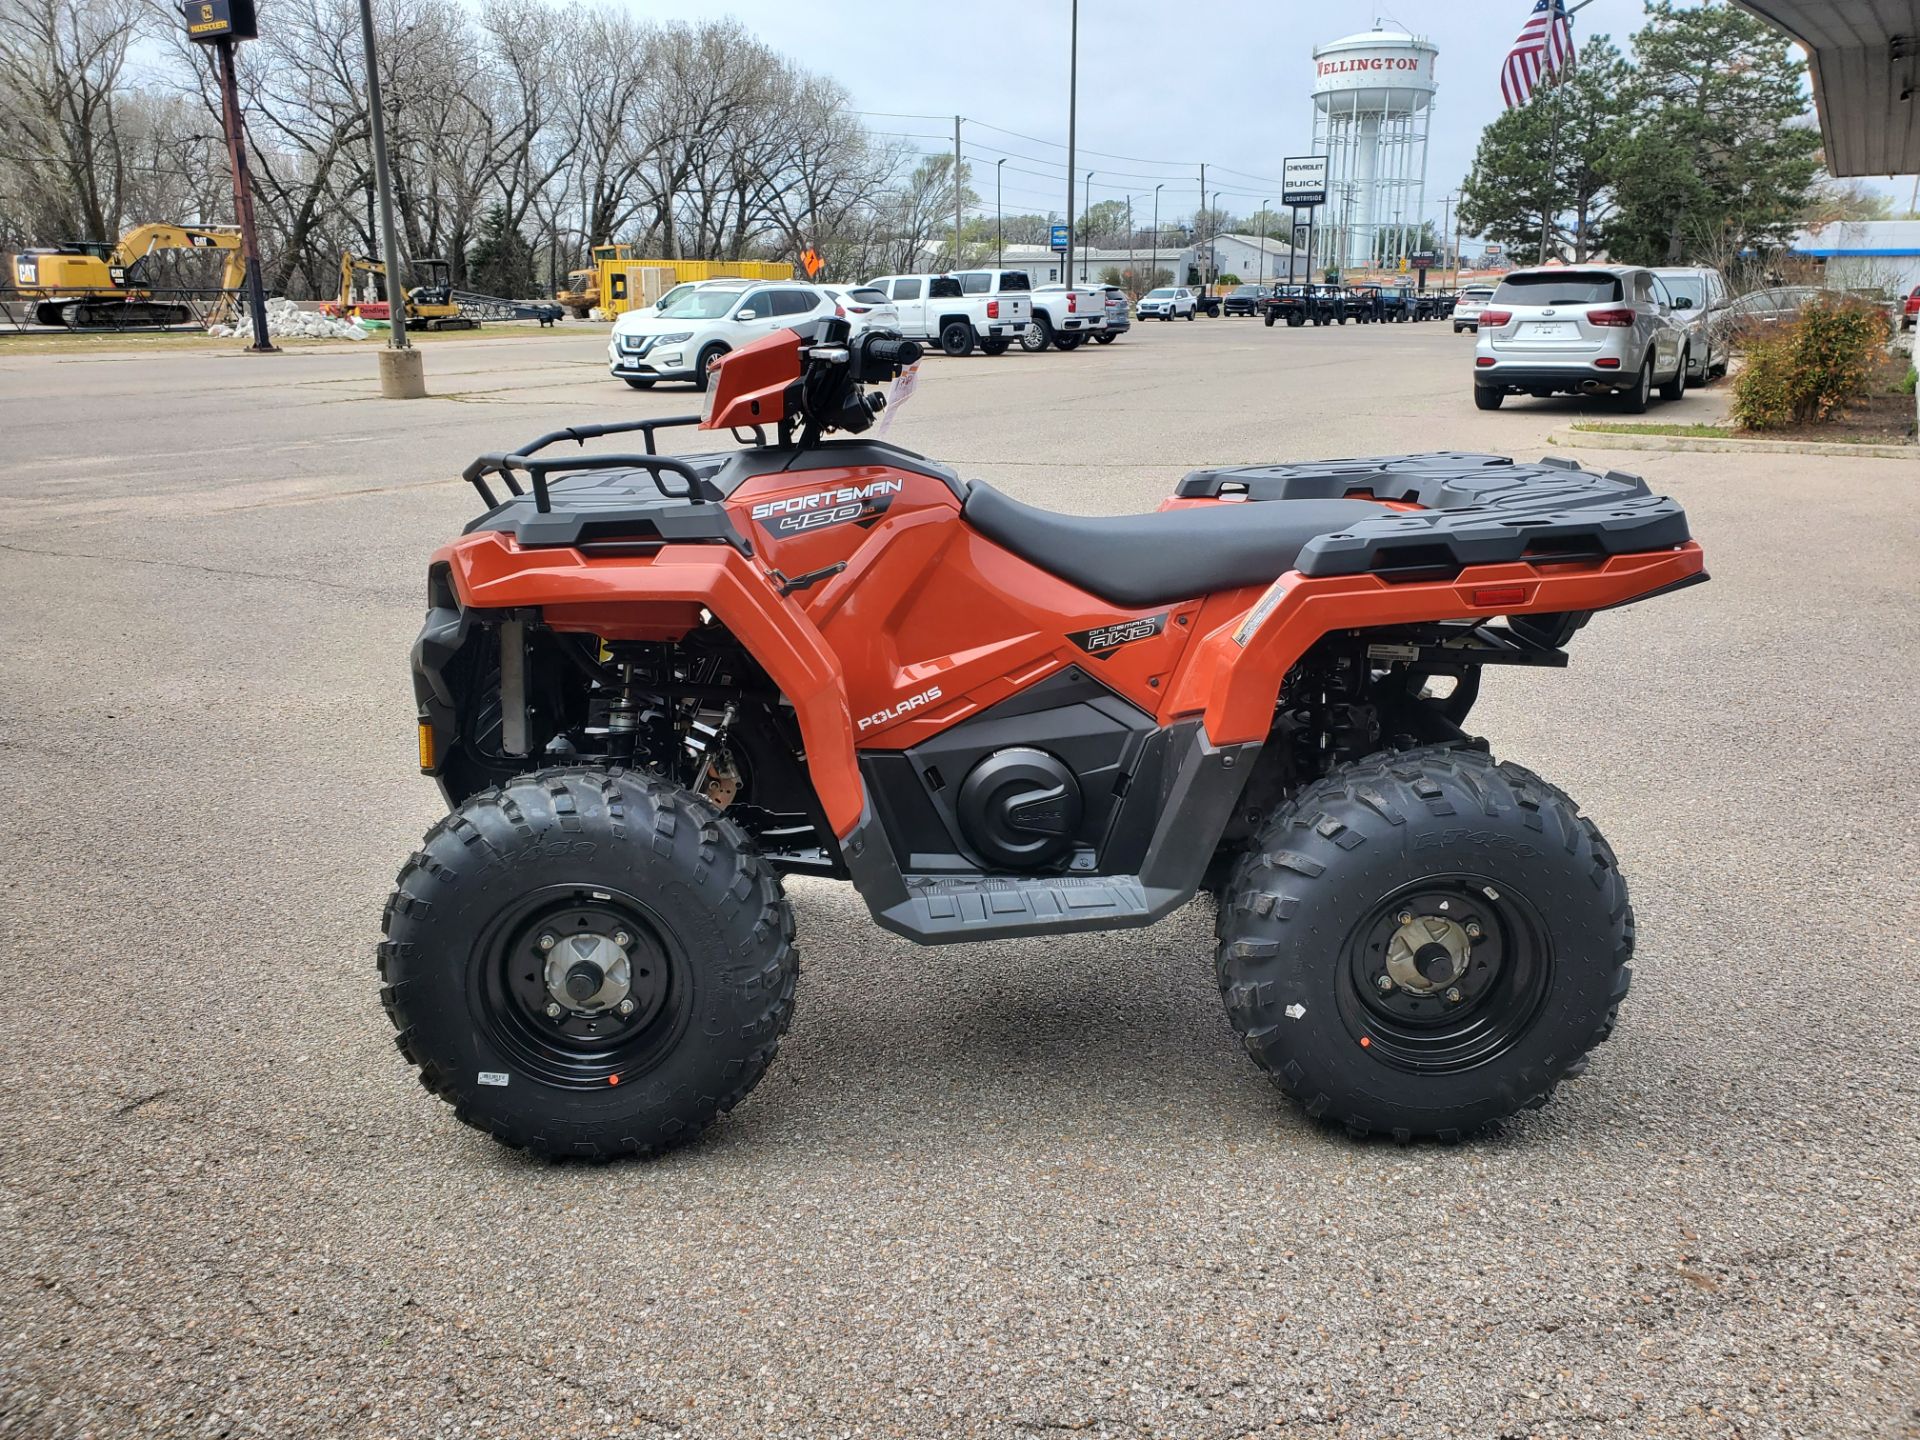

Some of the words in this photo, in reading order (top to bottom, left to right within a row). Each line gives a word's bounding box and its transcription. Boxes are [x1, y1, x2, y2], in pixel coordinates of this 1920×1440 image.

[1286, 180, 1322, 188] BUICK
[194, 237, 207, 246] CAT
[19, 262, 36, 283] CAT
[111, 268, 124, 278] CAT
[752, 479, 903, 519] SPORTSMAN
[780, 503, 862, 530] 450
[1088, 624, 1155, 649] AWD
[857, 686, 942, 731] POLARIS
